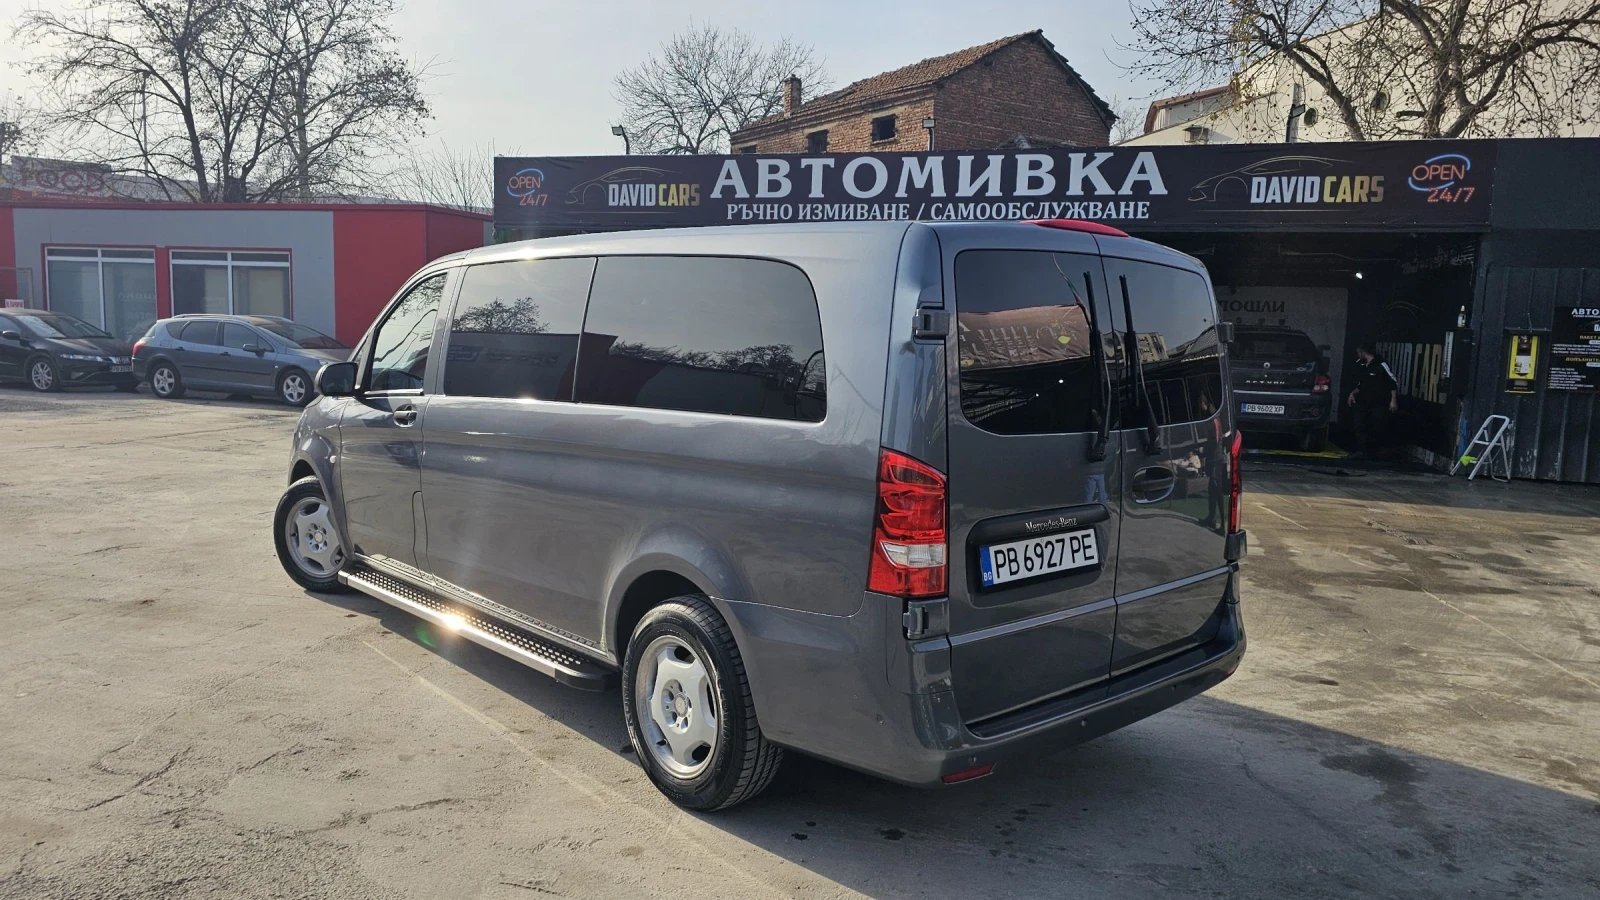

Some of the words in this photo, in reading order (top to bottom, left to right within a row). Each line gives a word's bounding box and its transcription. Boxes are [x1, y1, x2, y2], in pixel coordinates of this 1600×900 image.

[508, 176, 541, 189] OPEN
[710, 151, 1168, 199] АВТОМИВКА
[1412, 164, 1466, 181] OPEN
[608, 183, 656, 207] DAVID
[658, 183, 700, 207] CARS
[1250, 176, 1321, 204] DAVID
[1323, 175, 1385, 203] CARS
[1427, 187, 1476, 203] 24/7
[519, 193, 548, 207] 24/7
[726, 203, 793, 220] РЪЧНО
[798, 202, 910, 221] ИЗМИВАНЕ
[930, 201, 1150, 220] САМООБСЛУЖВАНЕ
[1411, 343, 1447, 405] CAR
[1025, 517, 1078, 532] Mercedes-Benz
[983, 571, 993, 582] BG
[993, 547, 1020, 579] PB
[1024, 538, 1065, 573] 6927
[1070, 533, 1095, 564] PE
